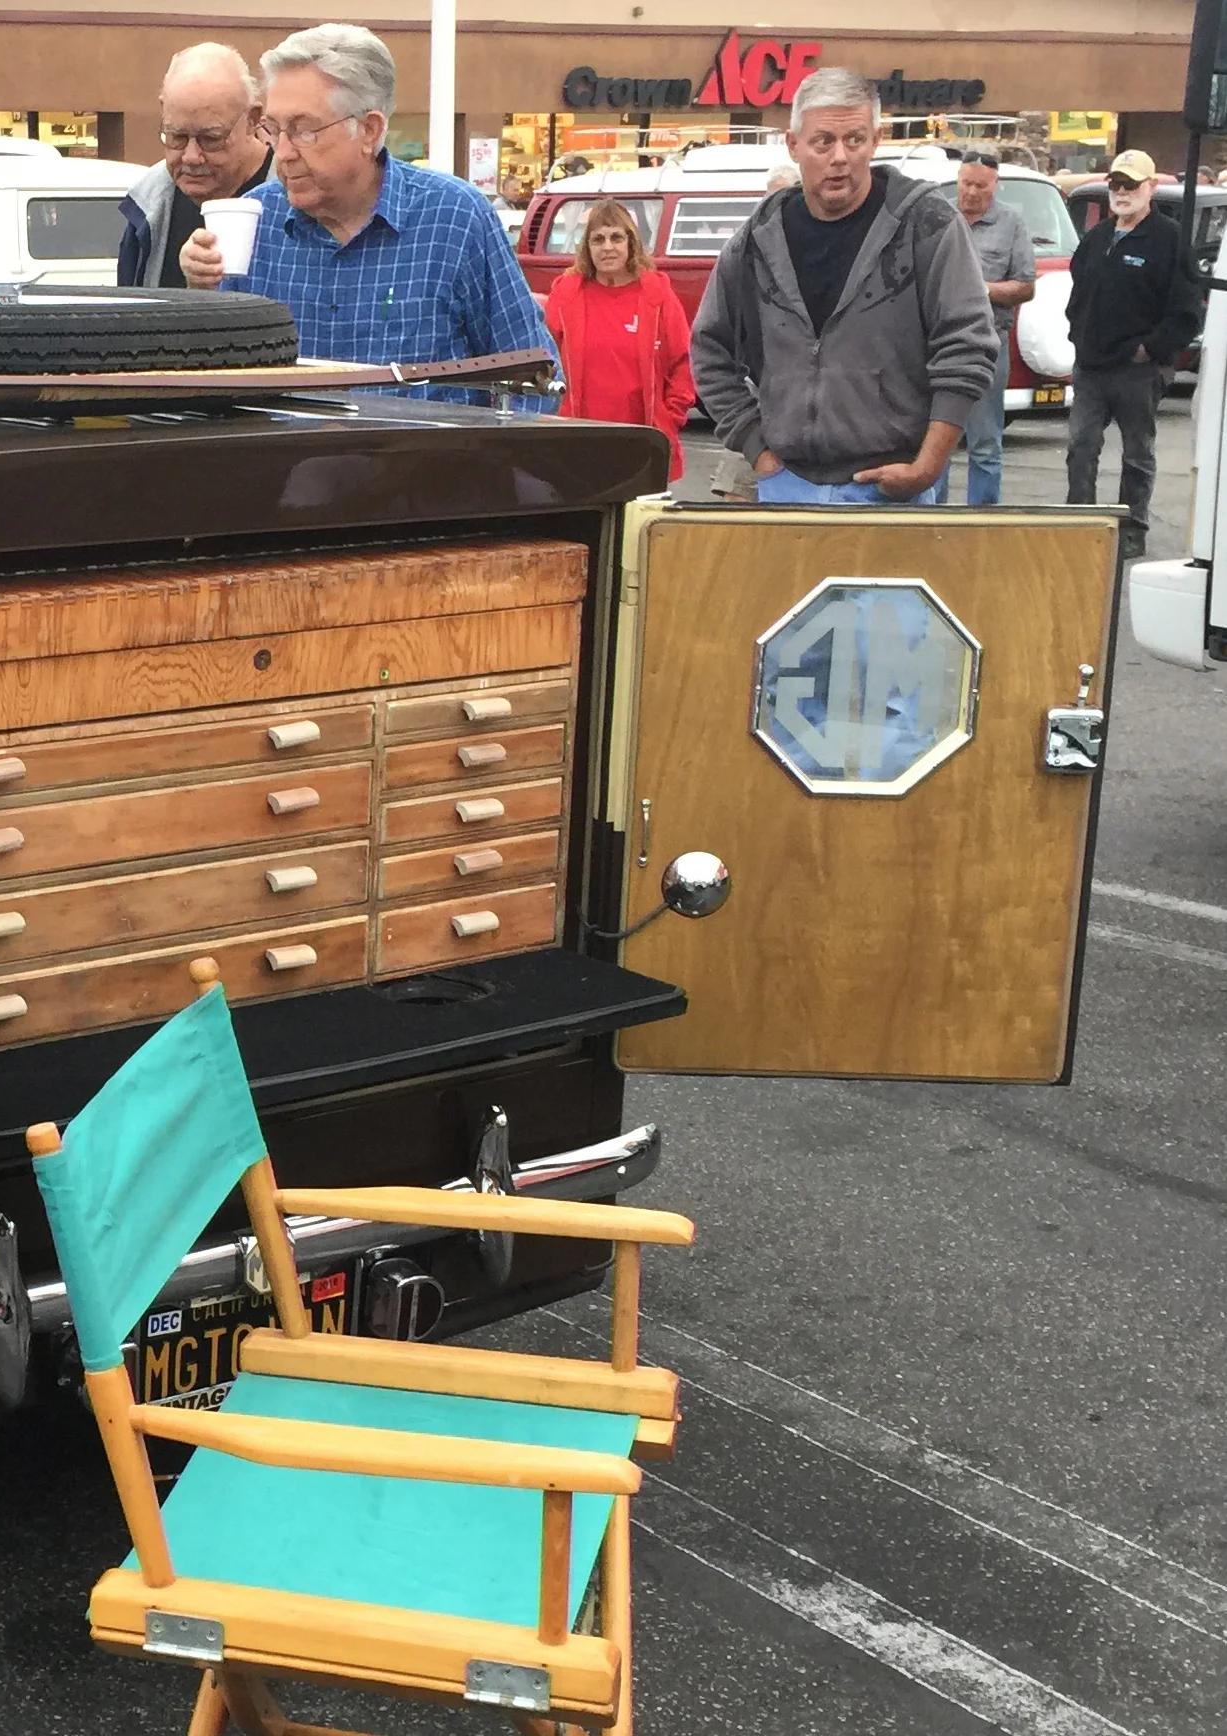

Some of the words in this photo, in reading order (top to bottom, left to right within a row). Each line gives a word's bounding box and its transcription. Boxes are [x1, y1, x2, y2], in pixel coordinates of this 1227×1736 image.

[563, 66, 692, 108] Crown
[694, 28, 824, 106] ACE
[149, 1313, 180, 1334] DEC
